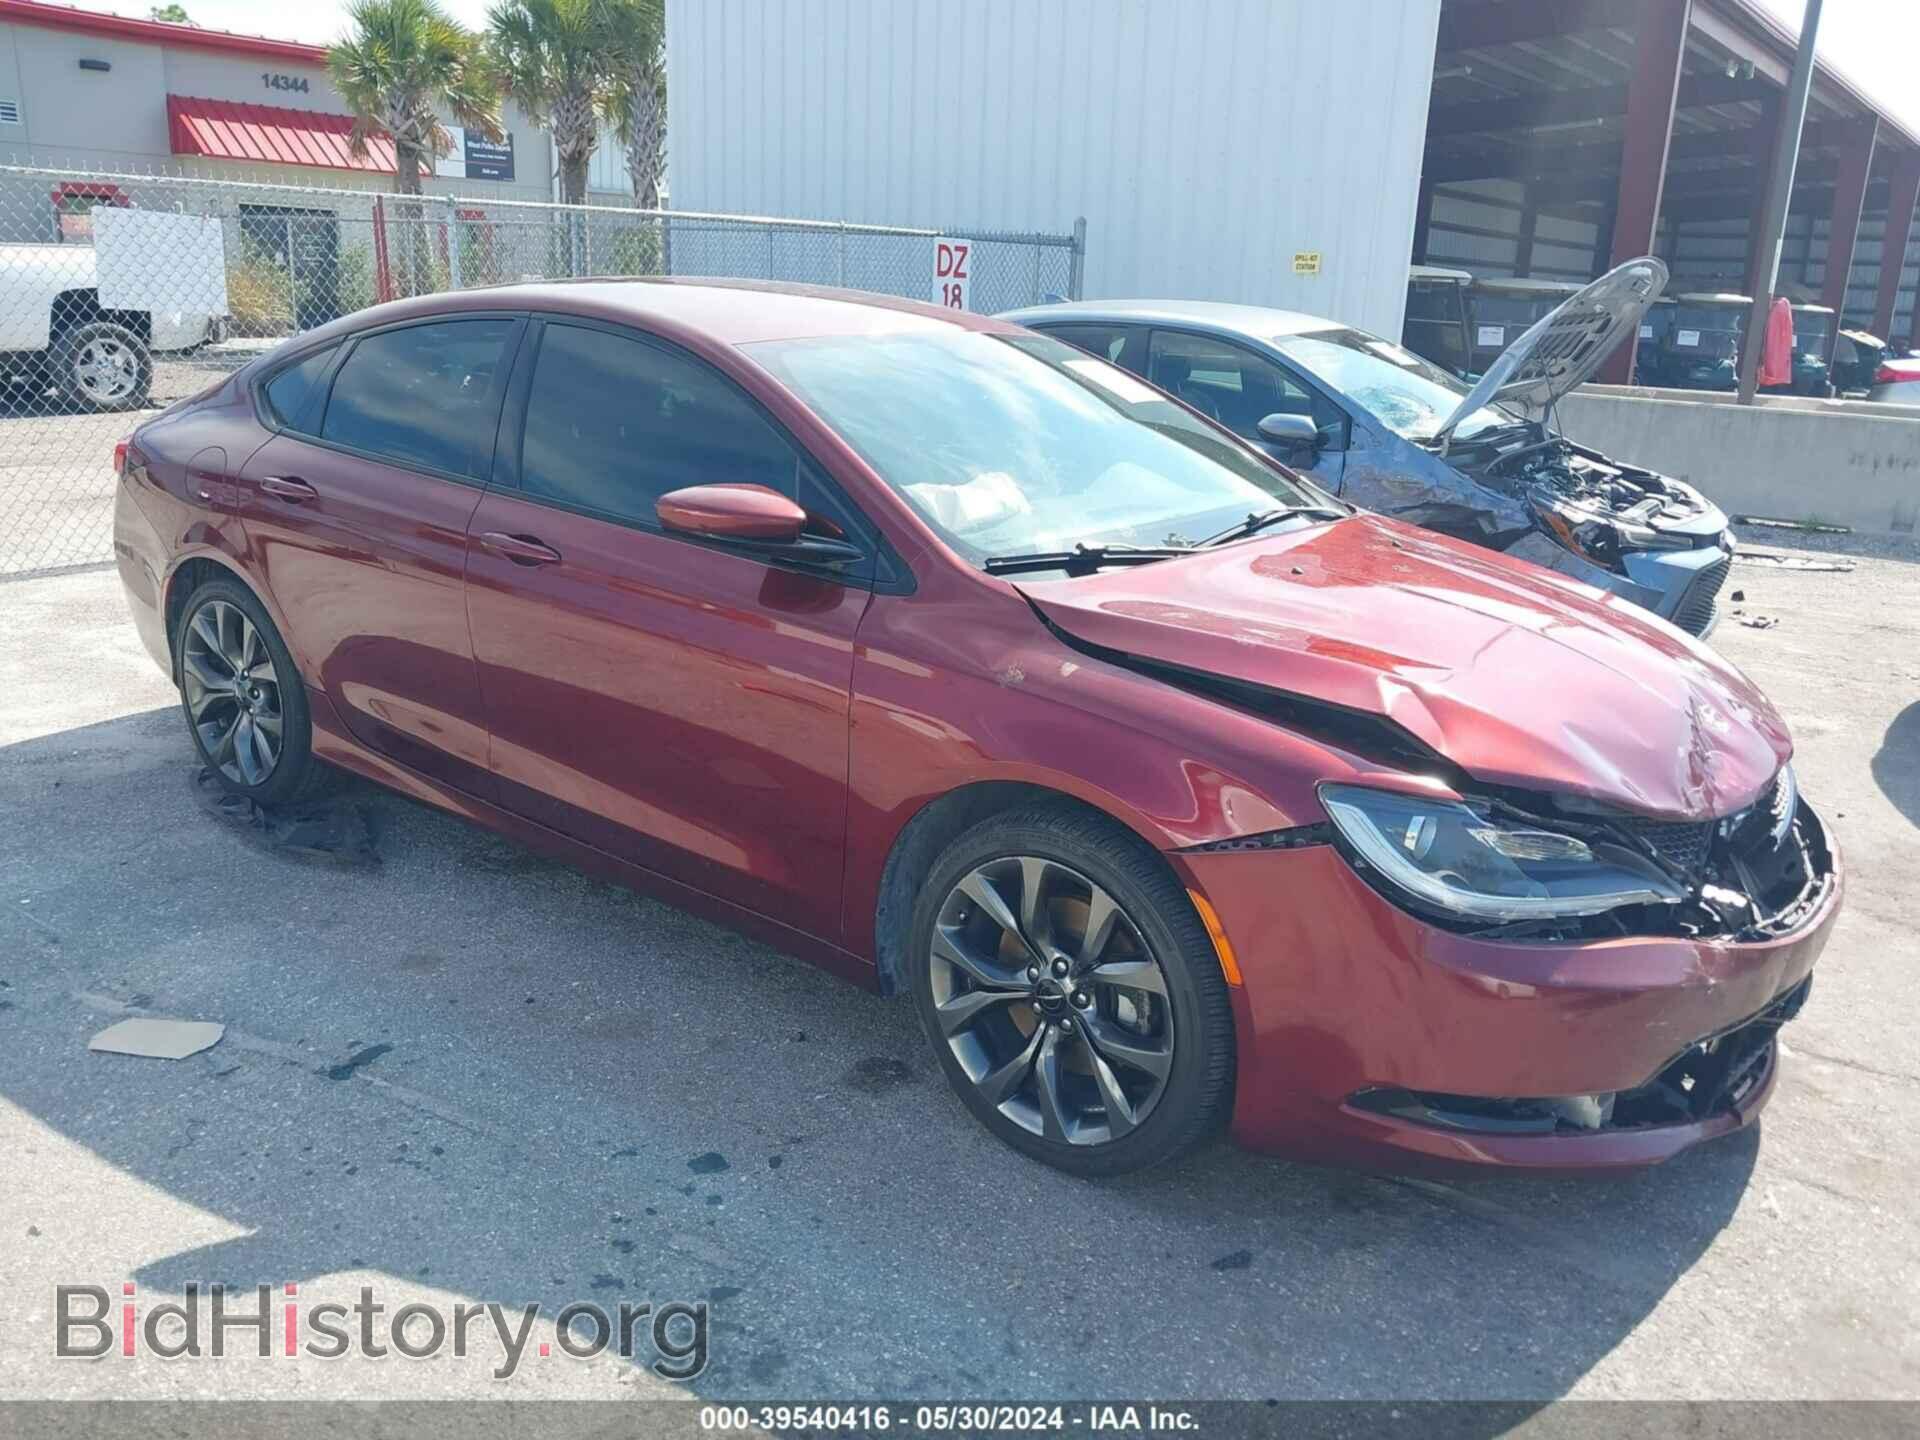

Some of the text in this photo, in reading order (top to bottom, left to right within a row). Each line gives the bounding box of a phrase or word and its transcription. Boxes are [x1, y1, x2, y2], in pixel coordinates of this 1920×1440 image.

[261, 73, 309, 94] 14344
[937, 244, 968, 278] DZ
[942, 283, 962, 310] 18
